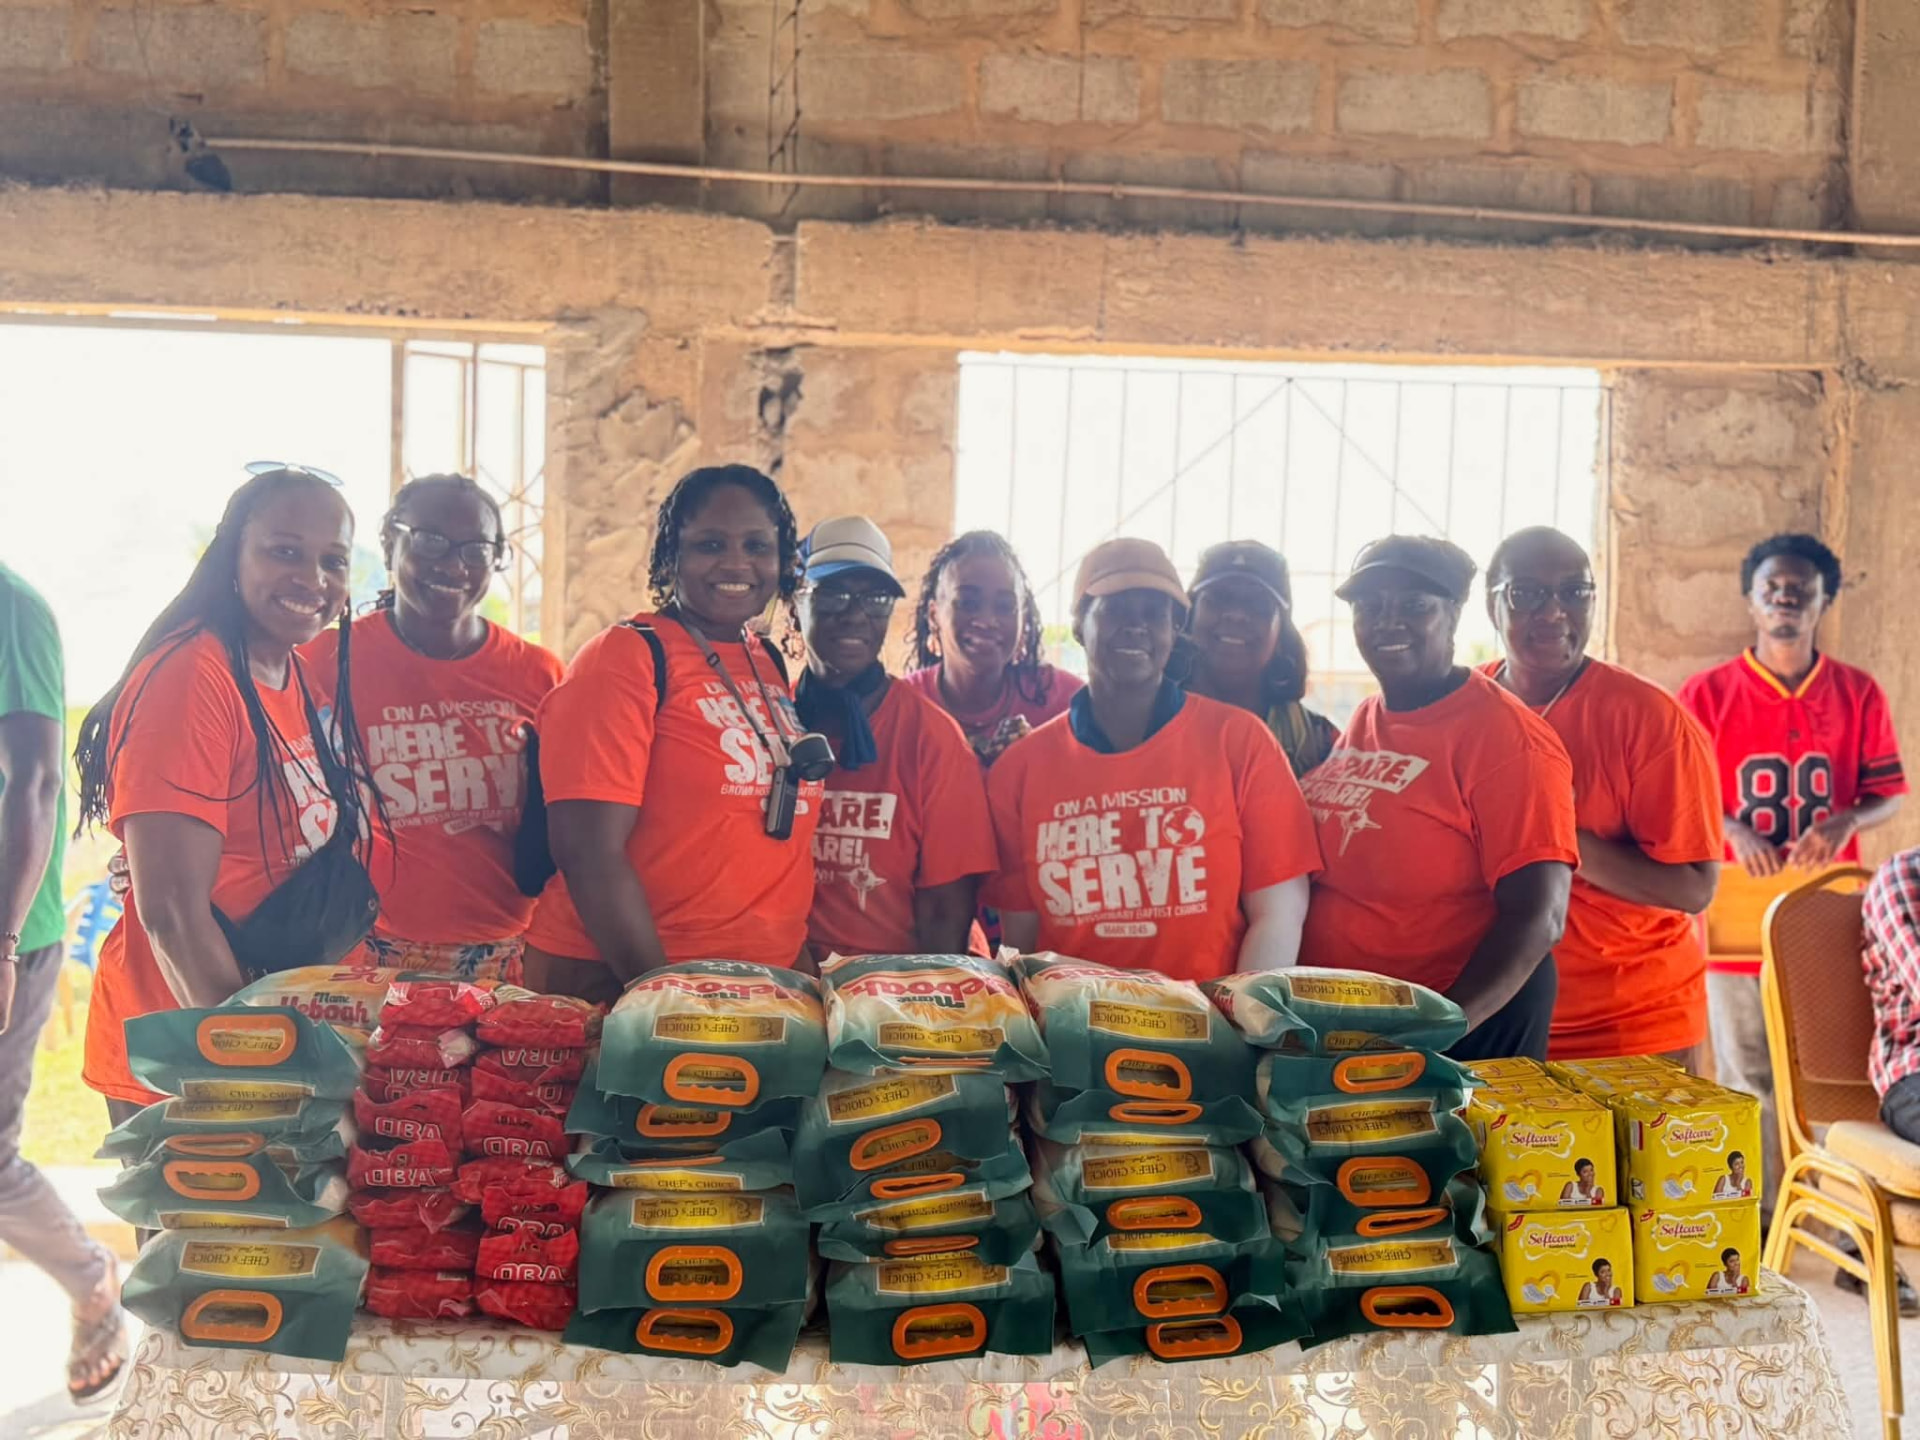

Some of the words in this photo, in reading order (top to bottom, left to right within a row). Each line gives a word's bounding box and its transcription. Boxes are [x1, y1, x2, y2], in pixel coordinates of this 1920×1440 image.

[382, 705, 415, 722] ON
[419, 703, 436, 720] A
[439, 700, 518, 719] MISSION
[367, 717, 467, 766] HERE
[373, 753, 528, 818] SERV
[1053, 800, 1081, 818] ON
[1083, 797, 1099, 812] A
[1101, 787, 1188, 809] MISSION
[1736, 752, 1832, 848] 88
[817, 797, 889, 831] ARE,
[1036, 811, 1122, 863] HERE
[811, 834, 863, 866] ARE!
[1037, 845, 1208, 917] SERVE
[1136, 906, 1172, 920] BAPTIST
[1298, 984, 1335, 996] CHOICE
[1093, 1012, 1131, 1025] CHOICE
[1132, 1017, 1167, 1030] CHEF's
[660, 1022, 701, 1033] CHOICE
[884, 1031, 925, 1042] CHOICE
[874, 1088, 910, 1106] CHEF's
[833, 1097, 874, 1114] CHOICE
[1316, 1124, 1354, 1136] CHOICE
[1670, 1127, 1713, 1144] Softcare
[1510, 1130, 1559, 1147] Softcare
[1090, 1166, 1129, 1179] CHOICE
[1131, 1163, 1167, 1175] CHEF's
[695, 1181, 735, 1189] CHOICE
[640, 1207, 679, 1218] CHOICE
[681, 1207, 718, 1218] CHEF's
[1660, 1222, 1706, 1238] Softcare
[1528, 1232, 1576, 1248] Softcare
[188, 1253, 230, 1265] CHOICE
[885, 1272, 924, 1285] CHOICE
[926, 1269, 962, 1282] CHEF's
